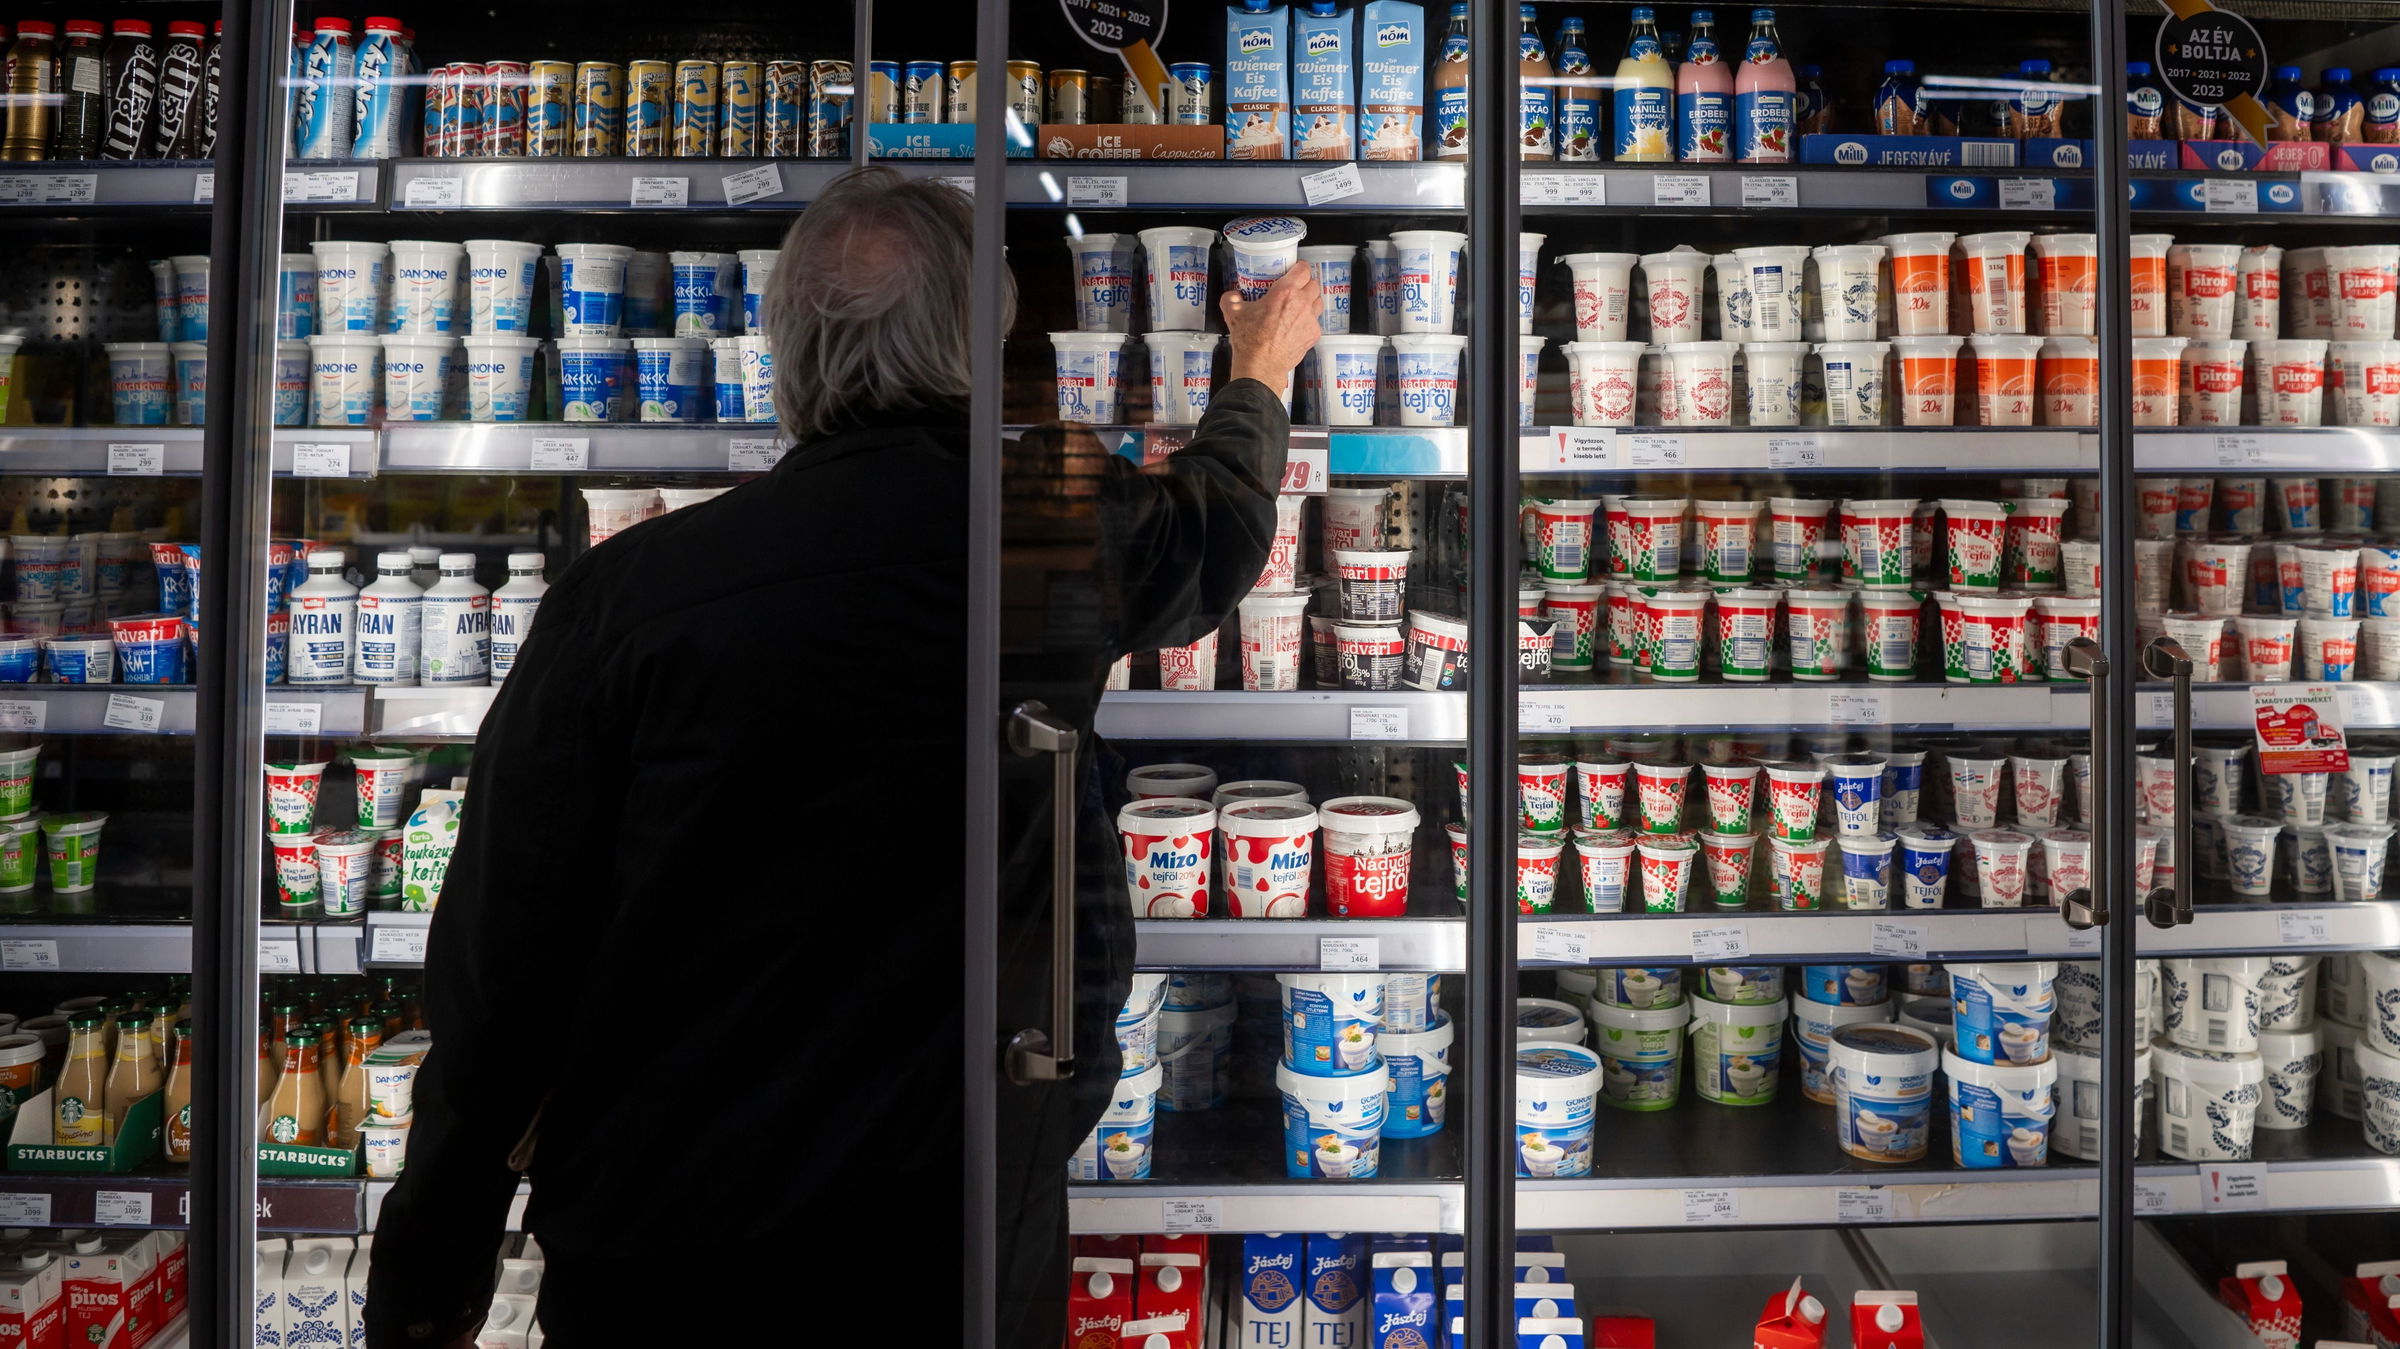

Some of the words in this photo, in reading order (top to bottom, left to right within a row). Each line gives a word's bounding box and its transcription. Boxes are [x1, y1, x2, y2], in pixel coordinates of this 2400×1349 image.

[1098, 3, 1120, 17] 2021
[1127, 12, 1151, 26] 2022
[1090, 19, 1124, 40] 2023
[2189, 29, 2210, 43] AZ
[2213, 26, 2234, 44] ÉV
[2182, 44, 2242, 62] BOLTJA
[1230, 60, 1282, 73] Wiener
[1296, 62, 1349, 75] Wiener
[1364, 62, 1420, 74] Wiener
[1245, 73, 1265, 85] Eis
[1312, 74, 1333, 86] Eis
[1382, 74, 1402, 86] Eis
[2168, 67, 2191, 78] 2017
[2198, 69, 2221, 80] 2021
[2228, 70, 2251, 82] 2022
[1234, 87, 1278, 100] Kaffee
[1302, 89, 1345, 101] Kaffee
[1370, 89, 1414, 101] Kaffee
[2192, 84, 2225, 97] 2023
[1243, 103, 1270, 111] CLASSIC
[1310, 105, 1337, 113] CLASSIC
[1379, 105, 1406, 113] CLASSIC
[1628, 105, 1666, 114] VANILLE
[2371, 98, 2397, 111] Milli
[1689, 110, 1729, 119] ERDBEER
[1750, 109, 1790, 118] ERDBEER
[1559, 116, 1593, 125] KAKAO
[906, 136, 931, 148] ICE
[1097, 136, 1121, 148] ICE
[1151, 144, 1216, 160] Cappuccino
[1838, 149, 1864, 162] Milli
[2220, 154, 2241, 167] Milli
[331, 187, 348, 195] 1299
[757, 181, 770, 189] 299
[1335, 180, 1352, 191] 1499
[1953, 184, 1972, 194] Milli
[663, 191, 677, 200] 299
[1100, 192, 1113, 200] 399
[1544, 188, 1558, 196] 999
[1579, 188, 1593, 196] 999
[1684, 189, 1697, 197] 999
[1771, 189, 1784, 197] 999
[2272, 188, 2290, 198] Milli
[2191, 276, 2228, 290] piros
[2345, 276, 2384, 290] piros
[1410, 299, 1428, 309] 12%
[1909, 297, 1931, 311] 20%
[2191, 320, 2209, 328] 450g
[2200, 370, 2236, 384] piros
[2279, 370, 2316, 384] piros
[1402, 389, 1451, 413] tejföl
[1921, 399, 1942, 413] 20%
[2053, 399, 2073, 413] 20%
[2201, 414, 2219, 423] 450g
[2280, 415, 2299, 423] 450g
[1574, 437, 1606, 446] Vigyázzon,
[565, 455, 579, 463] 447
[763, 457, 777, 465] 588
[1663, 451, 1678, 459] 466
[1801, 452, 1815, 460] 432
[138, 459, 152, 467] 299
[327, 460, 341, 468] 274
[1962, 549, 1992, 563] Tejföl
[2029, 548, 2056, 561] Tejföl
[2368, 574, 2397, 586] piros
[292, 613, 342, 635] AYRAN
[2253, 645, 2284, 658] piros
[1178, 666, 1198, 677] 20%
[140, 713, 153, 723] 339
[1862, 709, 1875, 718] 454
[23, 718, 37, 726] 240
[299, 720, 313, 728] 699
[1548, 716, 1562, 725] 470
[1384, 726, 1398, 734] 566
[276, 801, 306, 814] Joghurt
[1529, 800, 1554, 812] Tejföl
[1645, 802, 1672, 815] Tejföl
[1711, 802, 1735, 815] Tejföl
[1839, 809, 1869, 822] TEJFÖL
[1150, 851, 1198, 870] Mizo
[1270, 851, 1309, 871] Mizo
[286, 871, 316, 884] Joghurt
[1153, 869, 1178, 884] tejföl
[1178, 870, 1196, 881] 20%
[1712, 872, 1735, 885] Tejföl
[1352, 869, 1409, 902] tejföl
[1531, 884, 1553, 896] Tejföl
[1913, 885, 1943, 897] TEJFÖL
[410, 945, 423, 953] 459
[1567, 945, 1581, 953] 268
[1726, 942, 1739, 951] 283
[1905, 942, 1918, 951] 179
[35, 953, 49, 962] 169
[275, 957, 289, 965] 139
[1351, 955, 1368, 963] 1464
[18, 1149, 105, 1161] STARBUCKS
[259, 1150, 346, 1168] STARBUCKS
[24, 1208, 41, 1216] 1099
[124, 1207, 142, 1215] 1099
[1713, 1204, 1731, 1213] 1044
[1195, 1215, 1212, 1223] 1208
[1249, 1254, 1294, 1275] Jásztej
[1312, 1253, 1357, 1276] Jásztej
[70, 1289, 119, 1310] piros
[130, 1281, 155, 1310] piros
[78, 1311, 91, 1320] TEJ
[1380, 1309, 1428, 1334] Jásztej
[32, 1309, 58, 1340] piros
[1074, 1314, 1123, 1337] Jásztej
[1249, 1321, 1290, 1349] TEJ
[1312, 1321, 1354, 1349] TEJ
